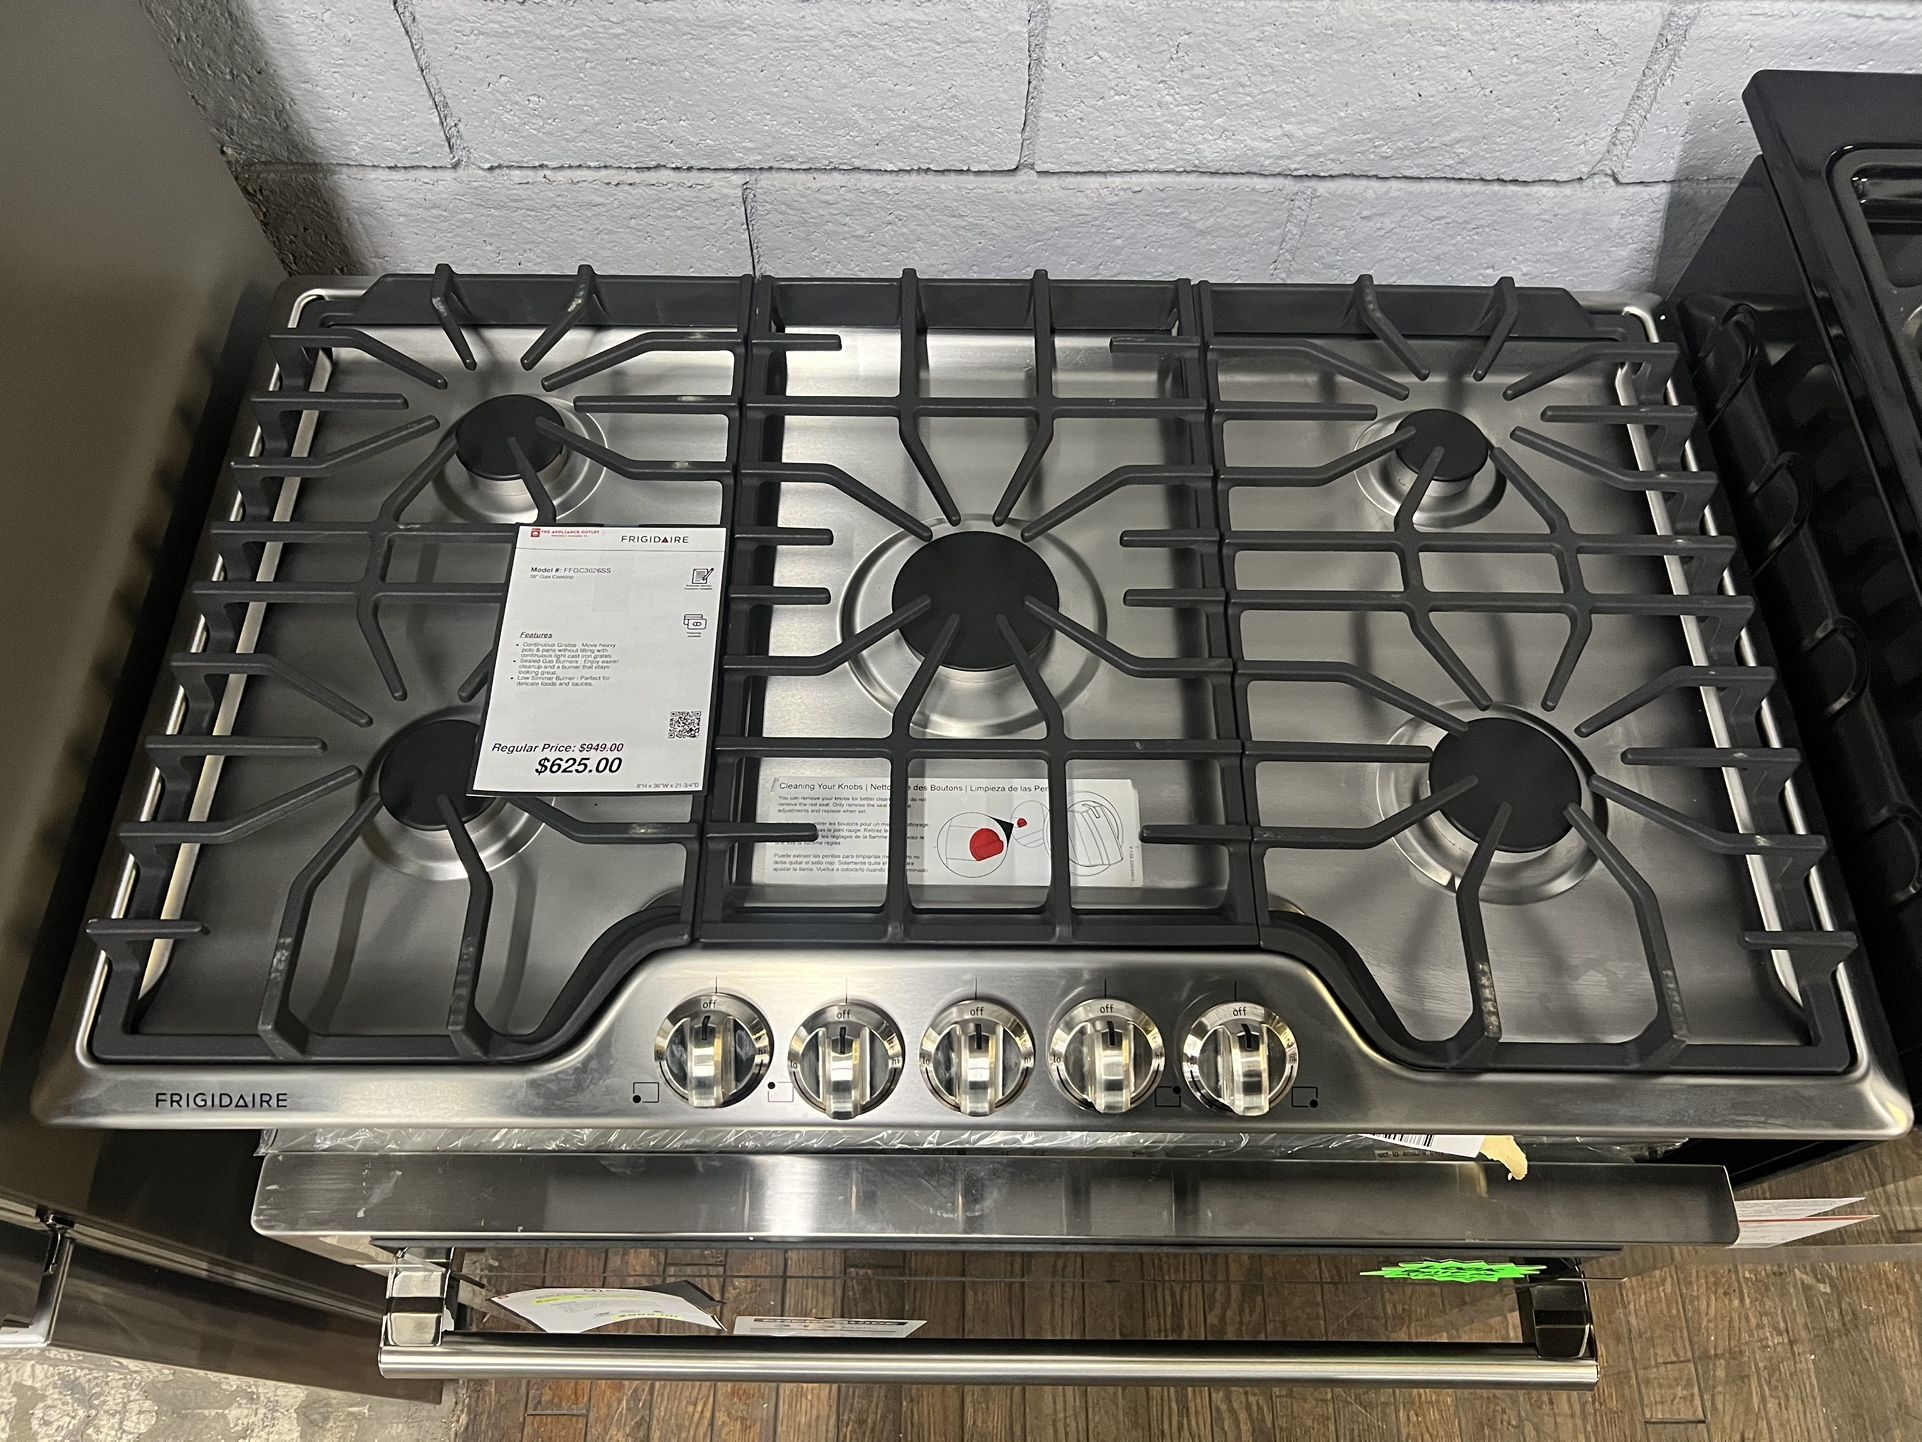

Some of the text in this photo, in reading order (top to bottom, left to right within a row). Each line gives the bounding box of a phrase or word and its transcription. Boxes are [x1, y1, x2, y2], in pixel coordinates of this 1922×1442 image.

[492, 743, 624, 754] Regular Price: $949.00
[535, 757, 622, 776] $625.00
[779, 782, 815, 791] Cleaning
[970, 785, 1005, 793] Limpieza
[702, 999, 717, 1009] off
[1100, 1004, 1114, 1014] off
[836, 1009, 850, 1020] off
[970, 1006, 984, 1017] off
[1232, 1007, 1246, 1016] off
[922, 1055, 930, 1064] lo
[1053, 1054, 1061, 1064] lo
[790, 1060, 798, 1069] lo
[156, 1093, 287, 1108] FRIGIDAIRE
